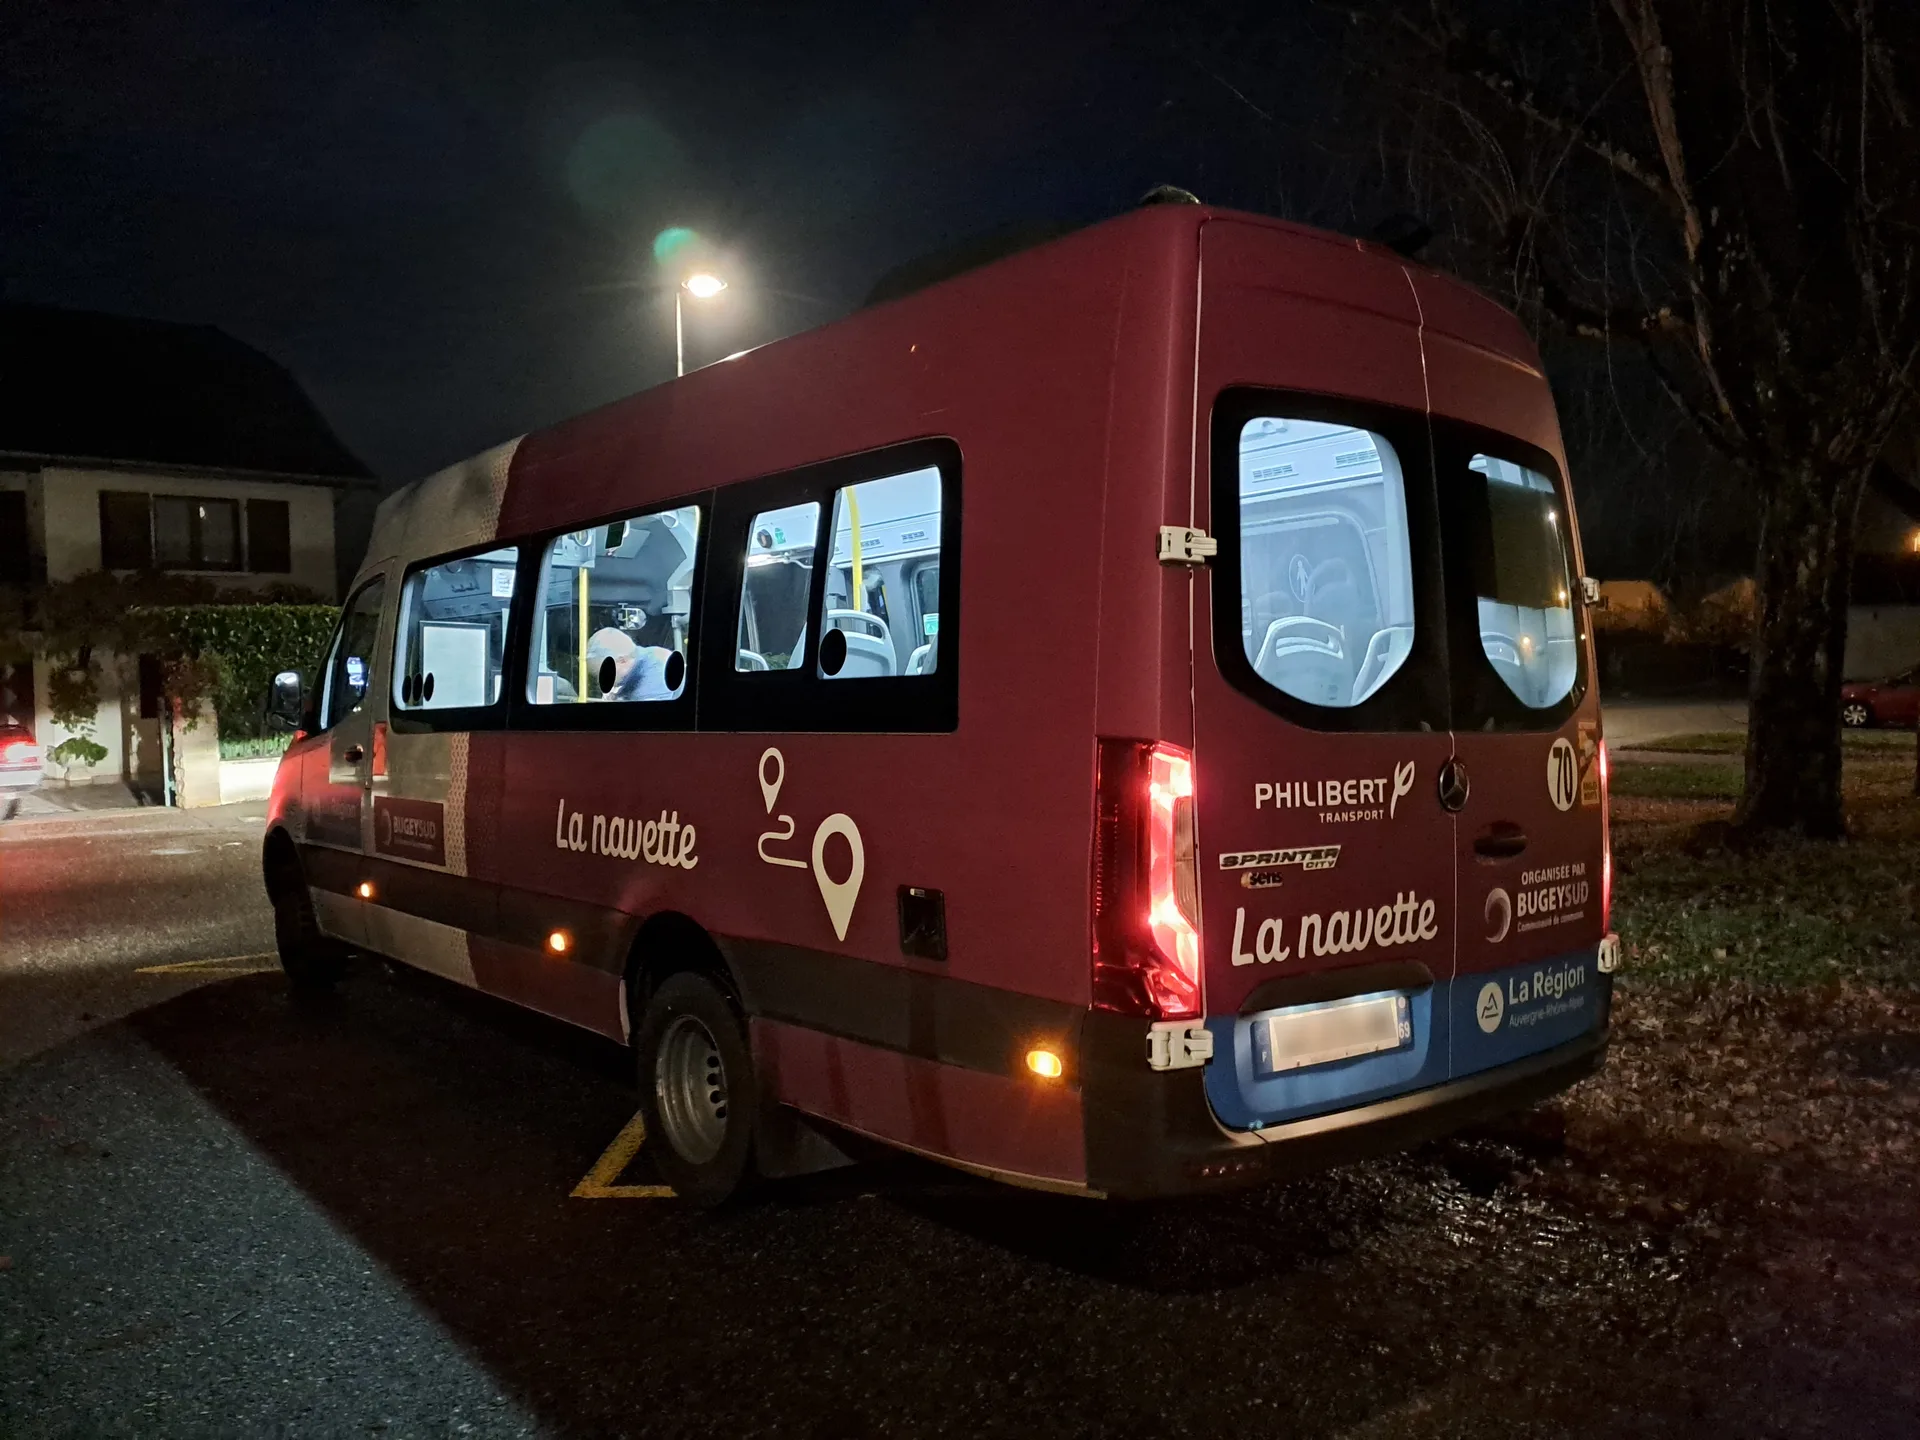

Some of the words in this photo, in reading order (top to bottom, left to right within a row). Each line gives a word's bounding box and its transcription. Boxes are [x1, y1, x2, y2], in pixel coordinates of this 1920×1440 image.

[1552, 745, 1573, 805] 70
[1254, 778, 1388, 810] PHILIBERT
[1318, 809, 1385, 824] TRANSPORT
[555, 798, 588, 852] La
[591, 809, 699, 870] navette
[1220, 847, 1340, 868] SPRINTER
[1305, 859, 1335, 870] CITY
[1521, 864, 1570, 886] ORGANISÉE
[1571, 862, 1586, 877] PAR
[1517, 880, 1589, 918] BUGEYSUD
[1230, 906, 1291, 967] La
[1297, 889, 1440, 960] navette
[1508, 977, 1529, 1006] La
[1533, 962, 1585, 1000] Région
[1398, 1021, 1410, 1039] 69
[1261, 1051, 1267, 1063] F
